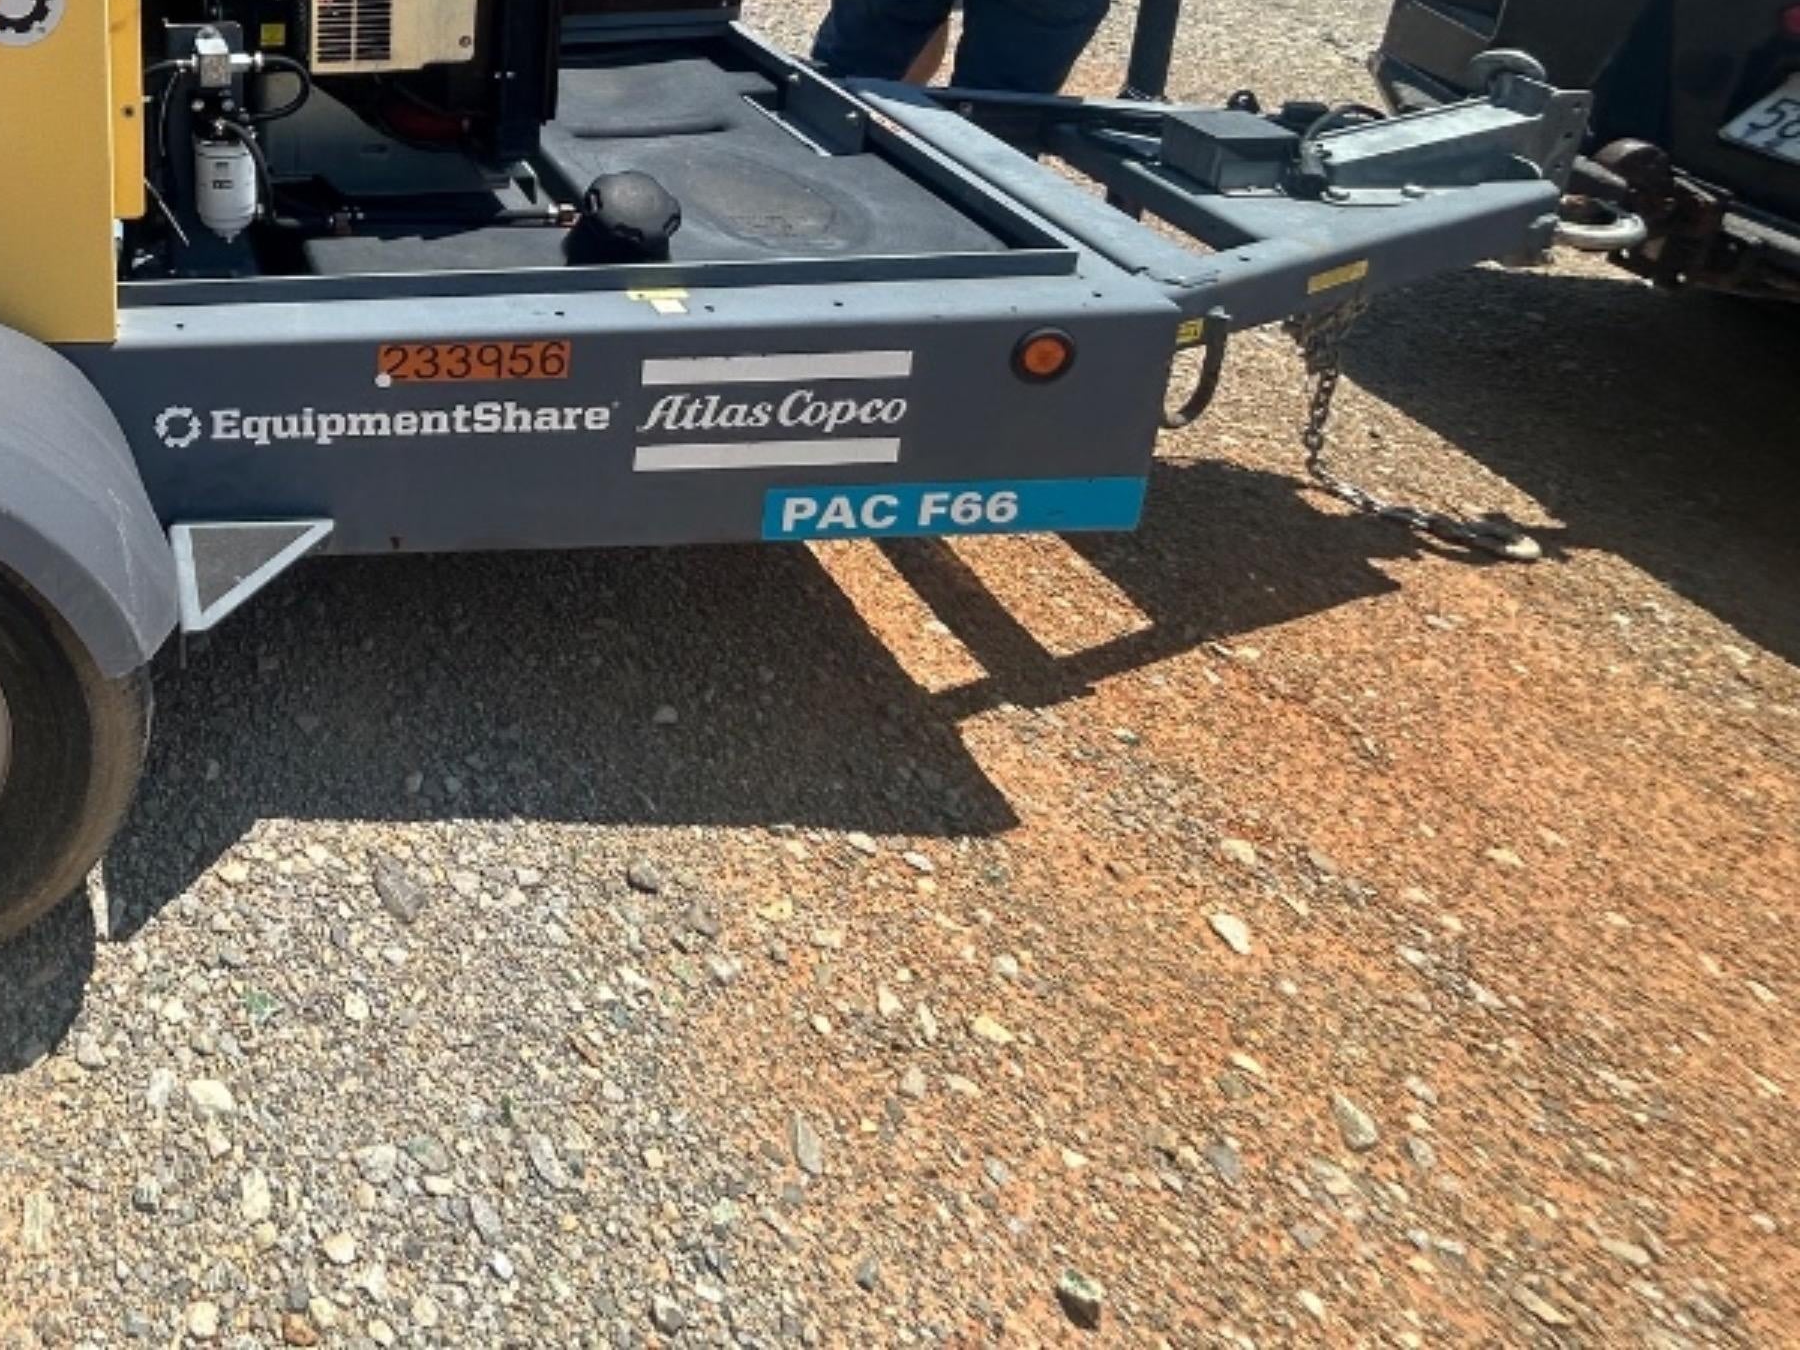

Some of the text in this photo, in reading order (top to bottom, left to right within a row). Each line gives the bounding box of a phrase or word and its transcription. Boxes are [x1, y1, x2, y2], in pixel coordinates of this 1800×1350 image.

[383, 341, 566, 379] 233956
[210, 400, 610, 445] EquipmentShare
[636, 388, 907, 432] Atlas Copco
[781, 490, 1019, 532] PAC F66
